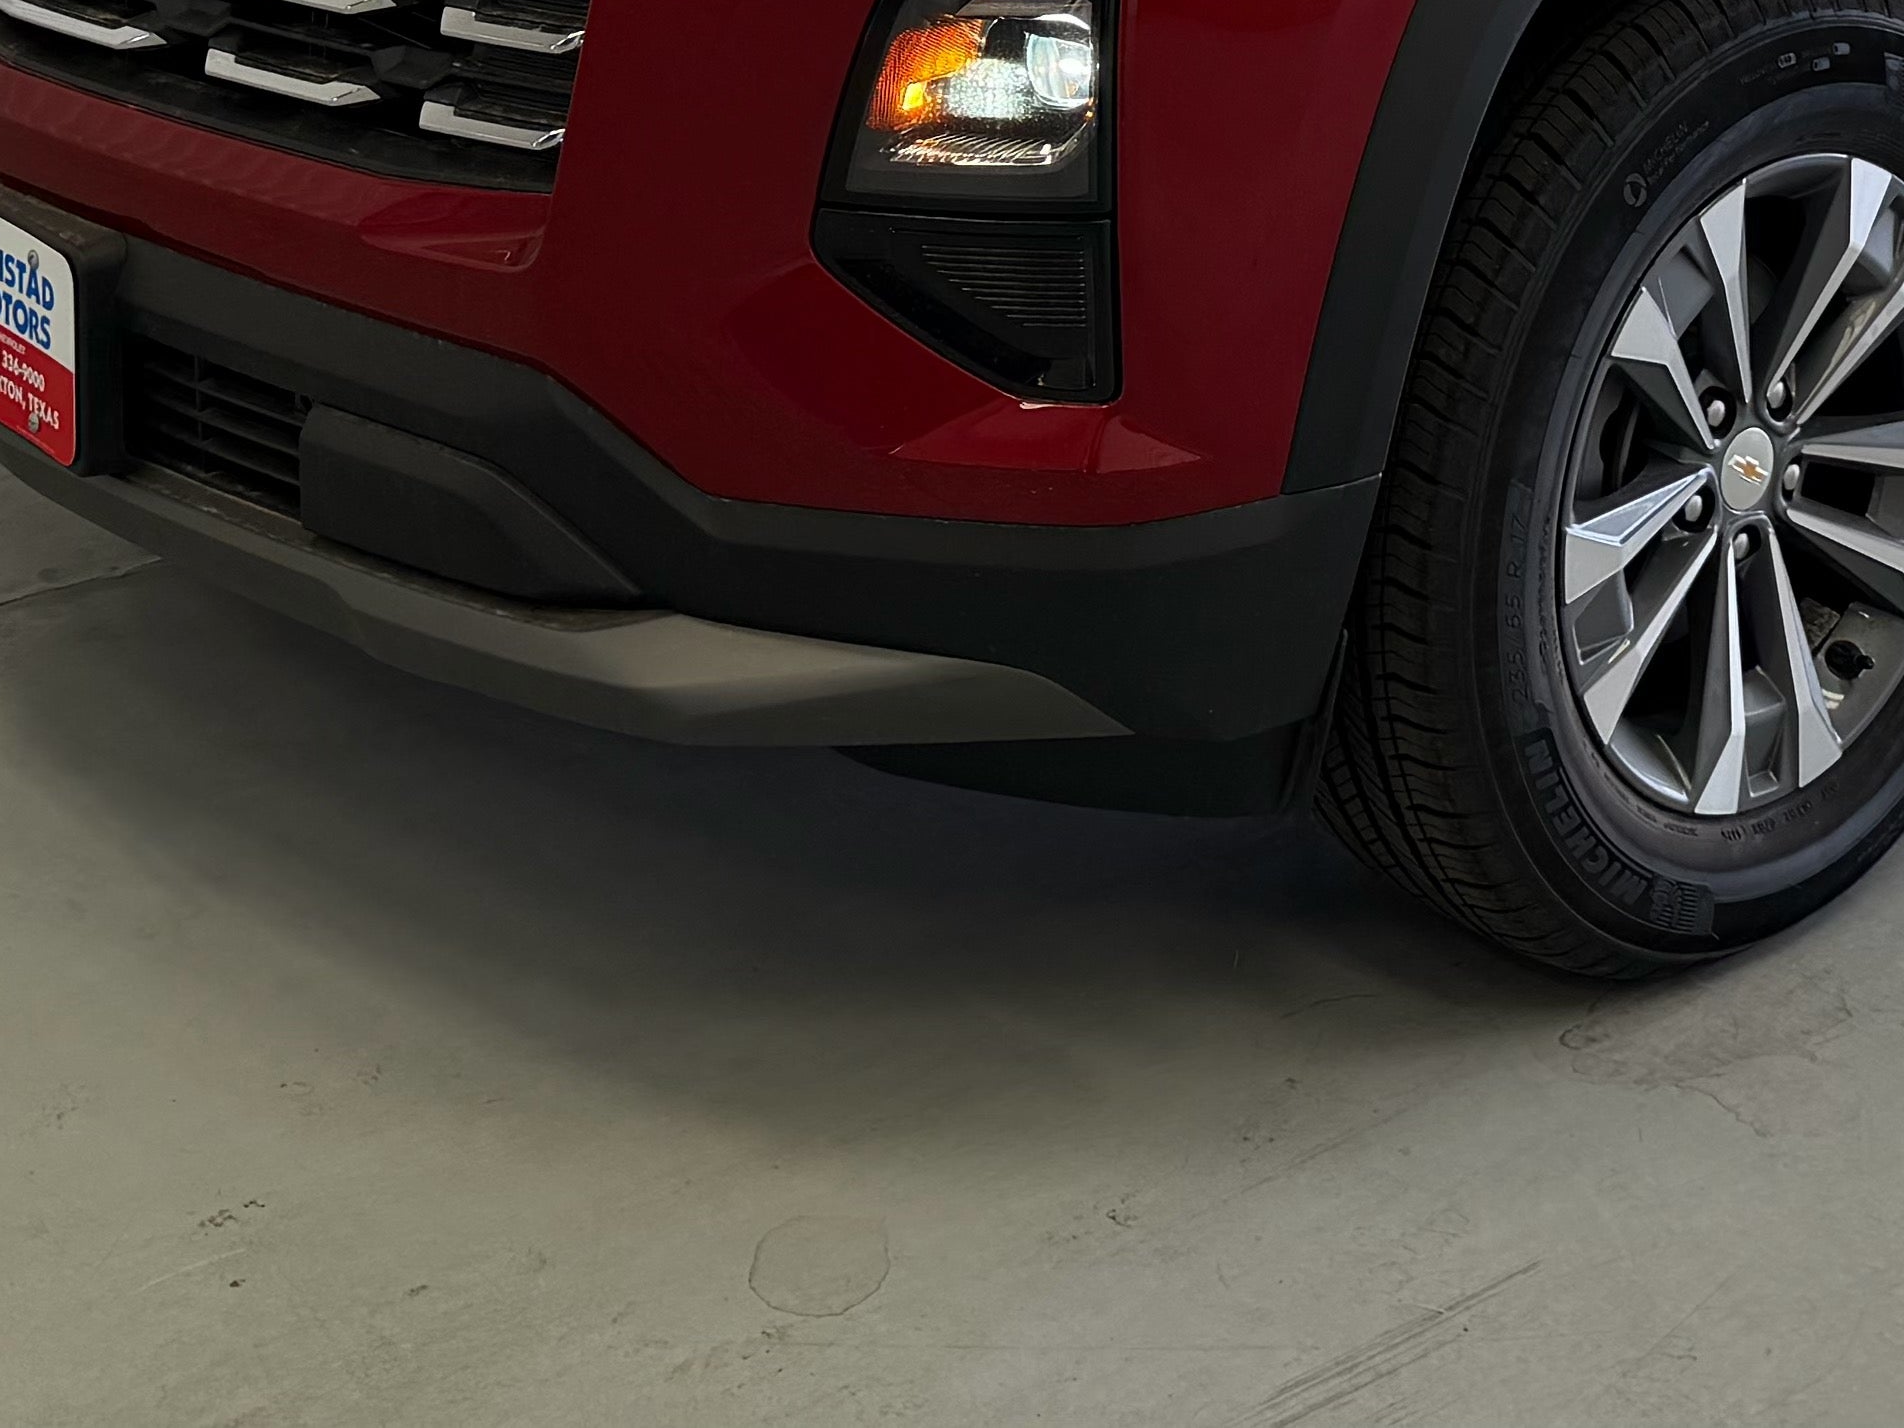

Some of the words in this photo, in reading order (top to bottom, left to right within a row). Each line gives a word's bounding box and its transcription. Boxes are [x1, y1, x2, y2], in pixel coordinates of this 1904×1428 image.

[1, 348, 46, 393] 336-9000
[27, 392, 60, 431] TEXAS
[1524, 736, 1649, 907] MICHELIN
